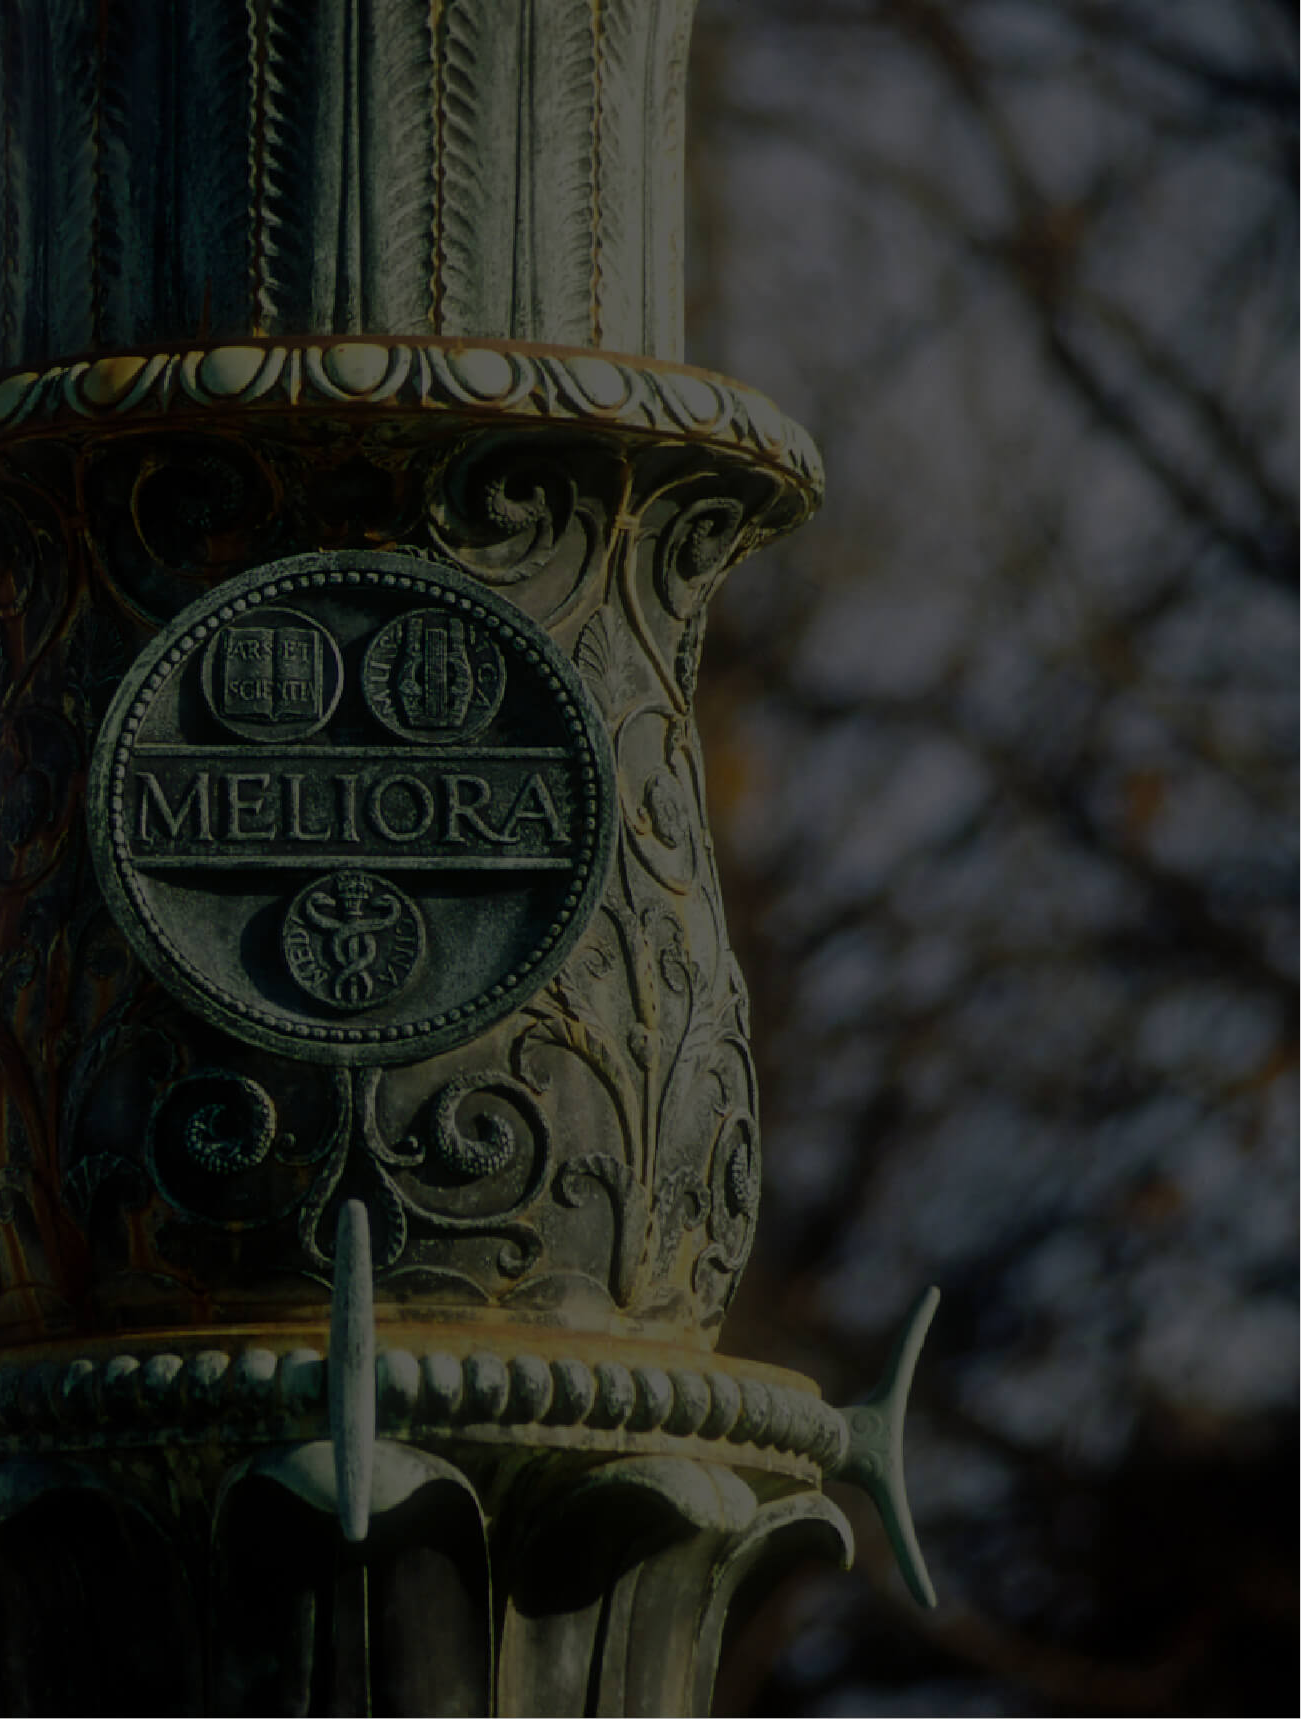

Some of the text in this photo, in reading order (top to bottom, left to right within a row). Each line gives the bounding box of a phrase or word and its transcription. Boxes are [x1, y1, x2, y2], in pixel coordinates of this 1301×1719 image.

[227, 639, 310, 663] ARS ET
[134, 770, 574, 847] MELIORA
